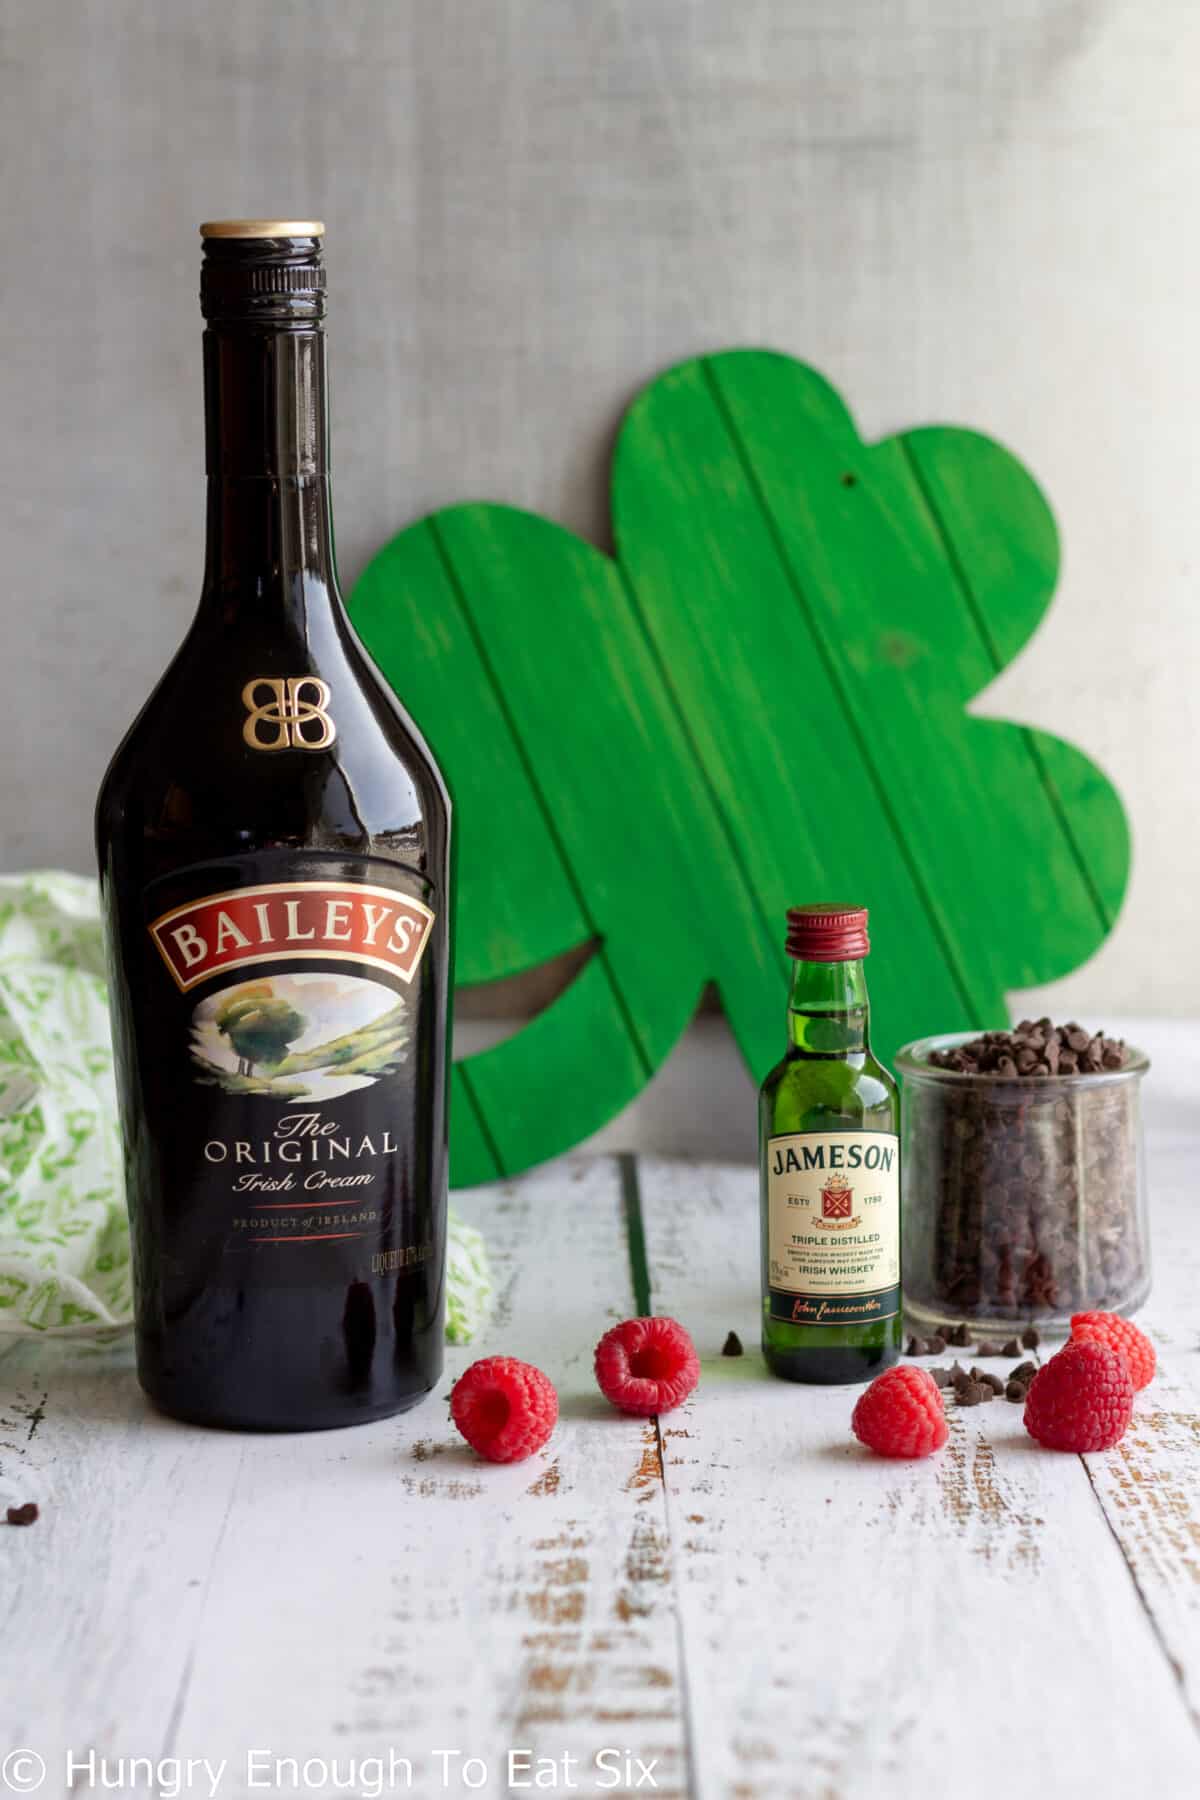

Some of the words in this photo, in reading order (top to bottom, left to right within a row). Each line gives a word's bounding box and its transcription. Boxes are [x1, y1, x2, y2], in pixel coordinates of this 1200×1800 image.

[170, 900, 418, 968] BAILEYS
[273, 1112, 339, 1138] The
[204, 1131, 398, 1163] ORIGINAL
[773, 1144, 893, 1175] JAMESON
[232, 1172, 296, 1192] Irish
[304, 1170, 376, 1191] Cream
[231, 1217, 298, 1229] PRODUCT
[318, 1210, 377, 1226] IRELAND
[791, 1234, 828, 1246] TRIPLE
[830, 1233, 880, 1246] DISTILLED
[799, 1264, 826, 1275] IRISH
[829, 1263, 875, 1275] WHISKEY
